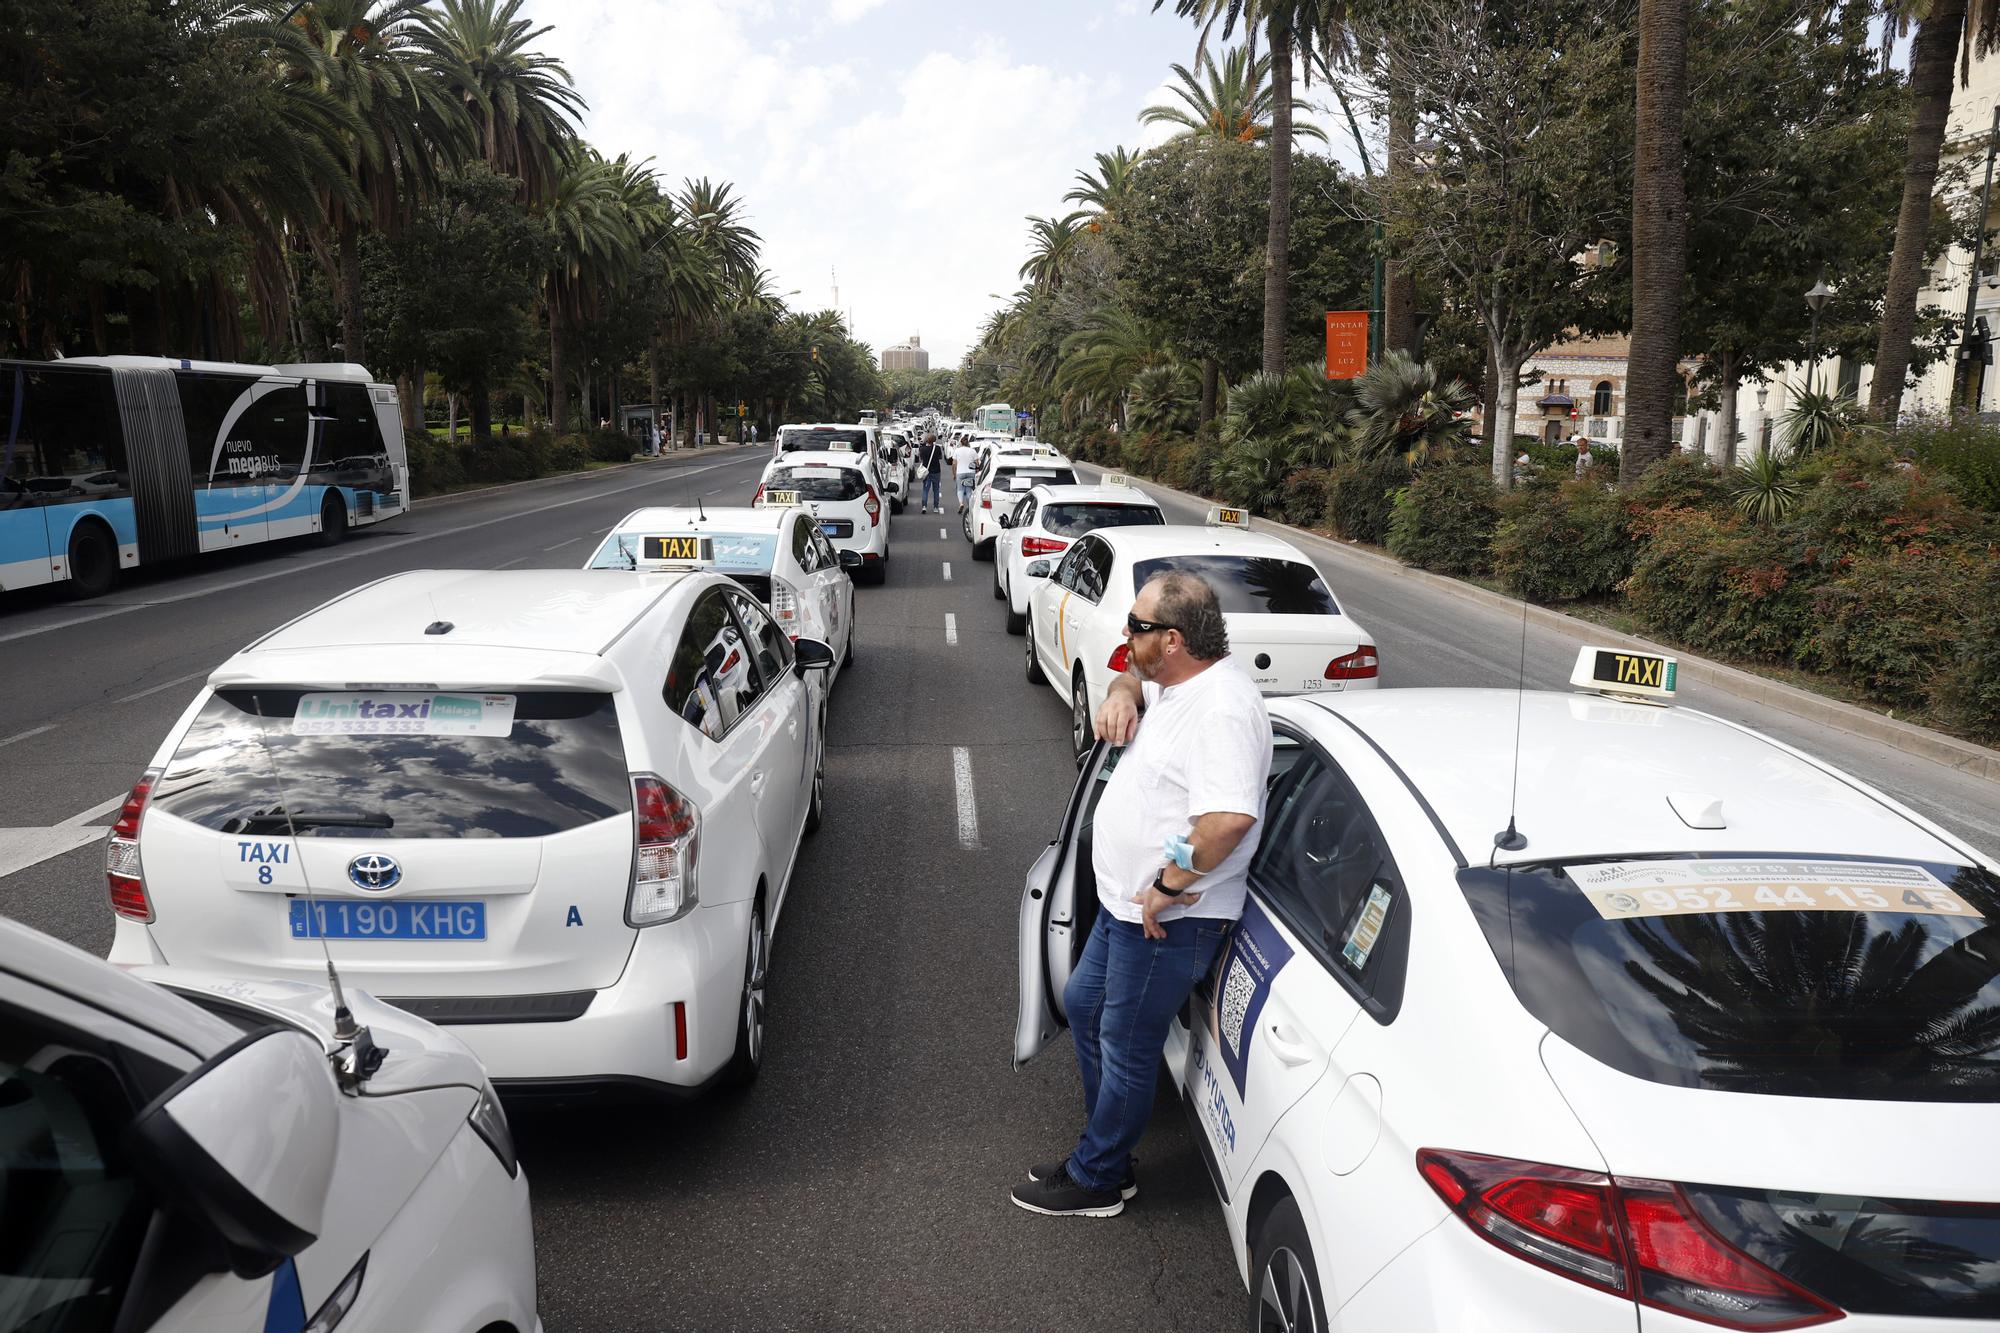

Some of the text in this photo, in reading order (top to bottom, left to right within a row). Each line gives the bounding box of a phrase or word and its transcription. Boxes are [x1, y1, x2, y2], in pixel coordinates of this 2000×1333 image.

[226, 440, 252, 453] nuevo
[228, 455, 280, 478] megaBUS
[774, 492, 793, 503] TAXI
[1220, 510, 1240, 524] TAXI
[659, 538, 697, 558] TAXI
[1615, 655, 1662, 686] TAXI
[1302, 680, 1322, 689] 1253
[302, 698, 431, 719] Unitaxi
[300, 720, 425, 734] 952 333 333
[237, 842, 290, 864] TAXI
[258, 865, 273, 885] 8
[1641, 885, 1962, 912] 952 44 15 45
[316, 905, 476, 935] 1190 KHG
[565, 905, 583, 927] A
